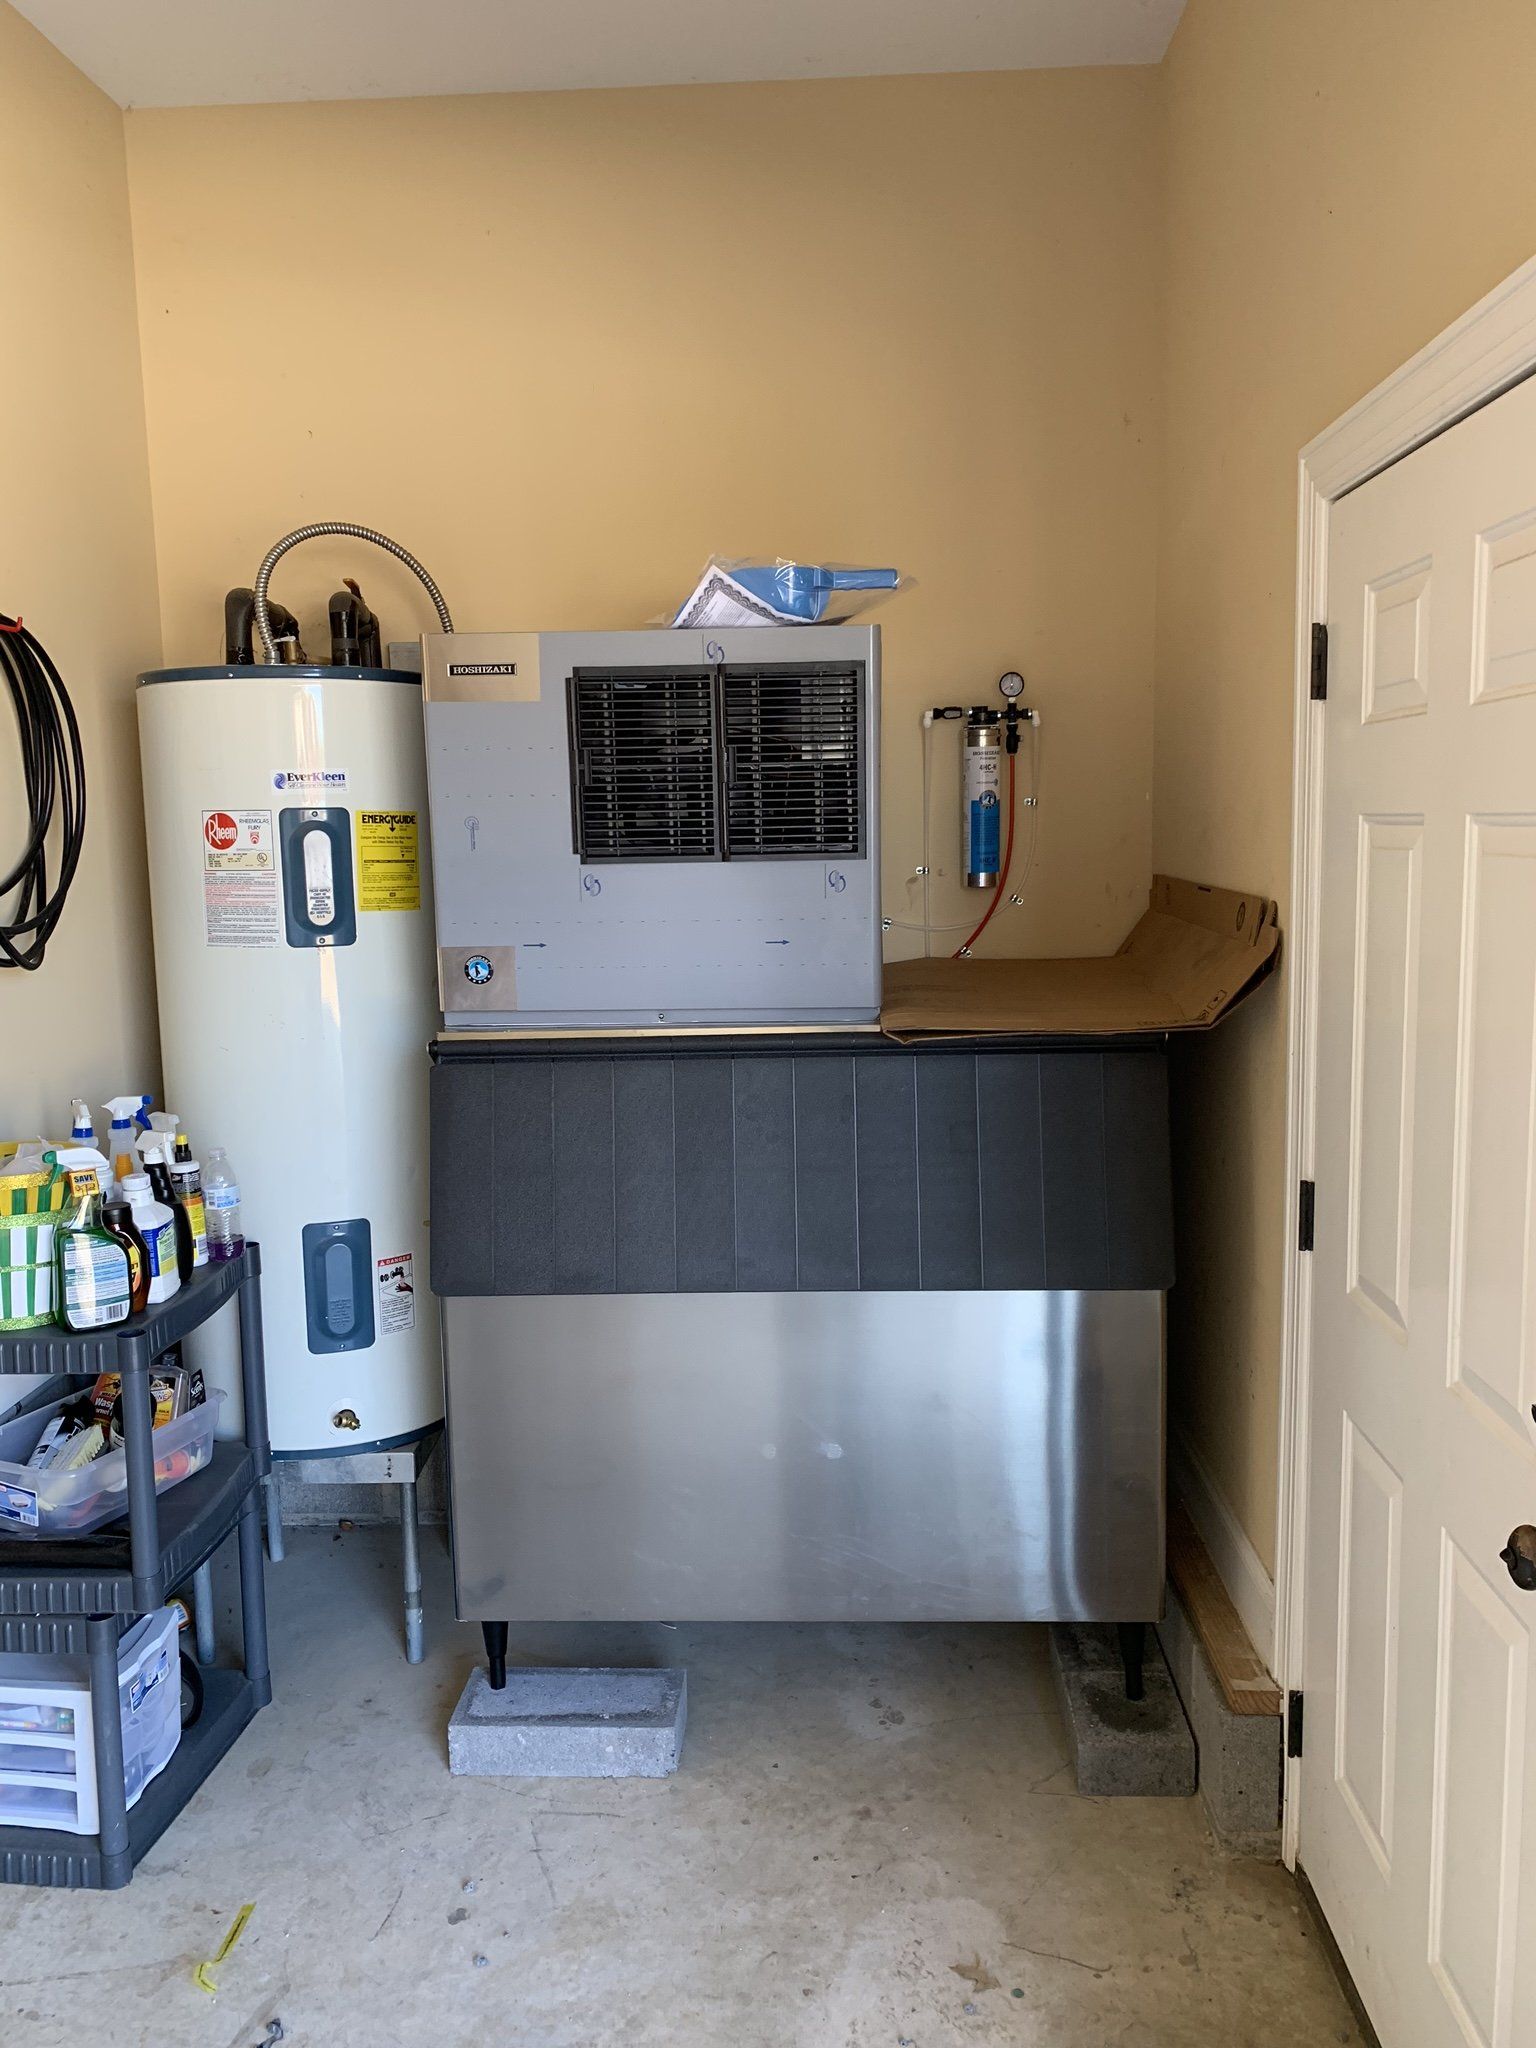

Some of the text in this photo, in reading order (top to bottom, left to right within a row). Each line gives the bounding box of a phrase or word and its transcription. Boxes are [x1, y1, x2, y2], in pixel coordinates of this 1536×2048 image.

[453, 665, 512, 674] HOSHIZAKI
[286, 771, 346, 782] EverKleen
[361, 814, 416, 825] ENERGYGUIDE
[205, 814, 237, 845] Rheem
[74, 1174, 94, 1183] SAVE
[386, 1254, 411, 1265] DANGER
